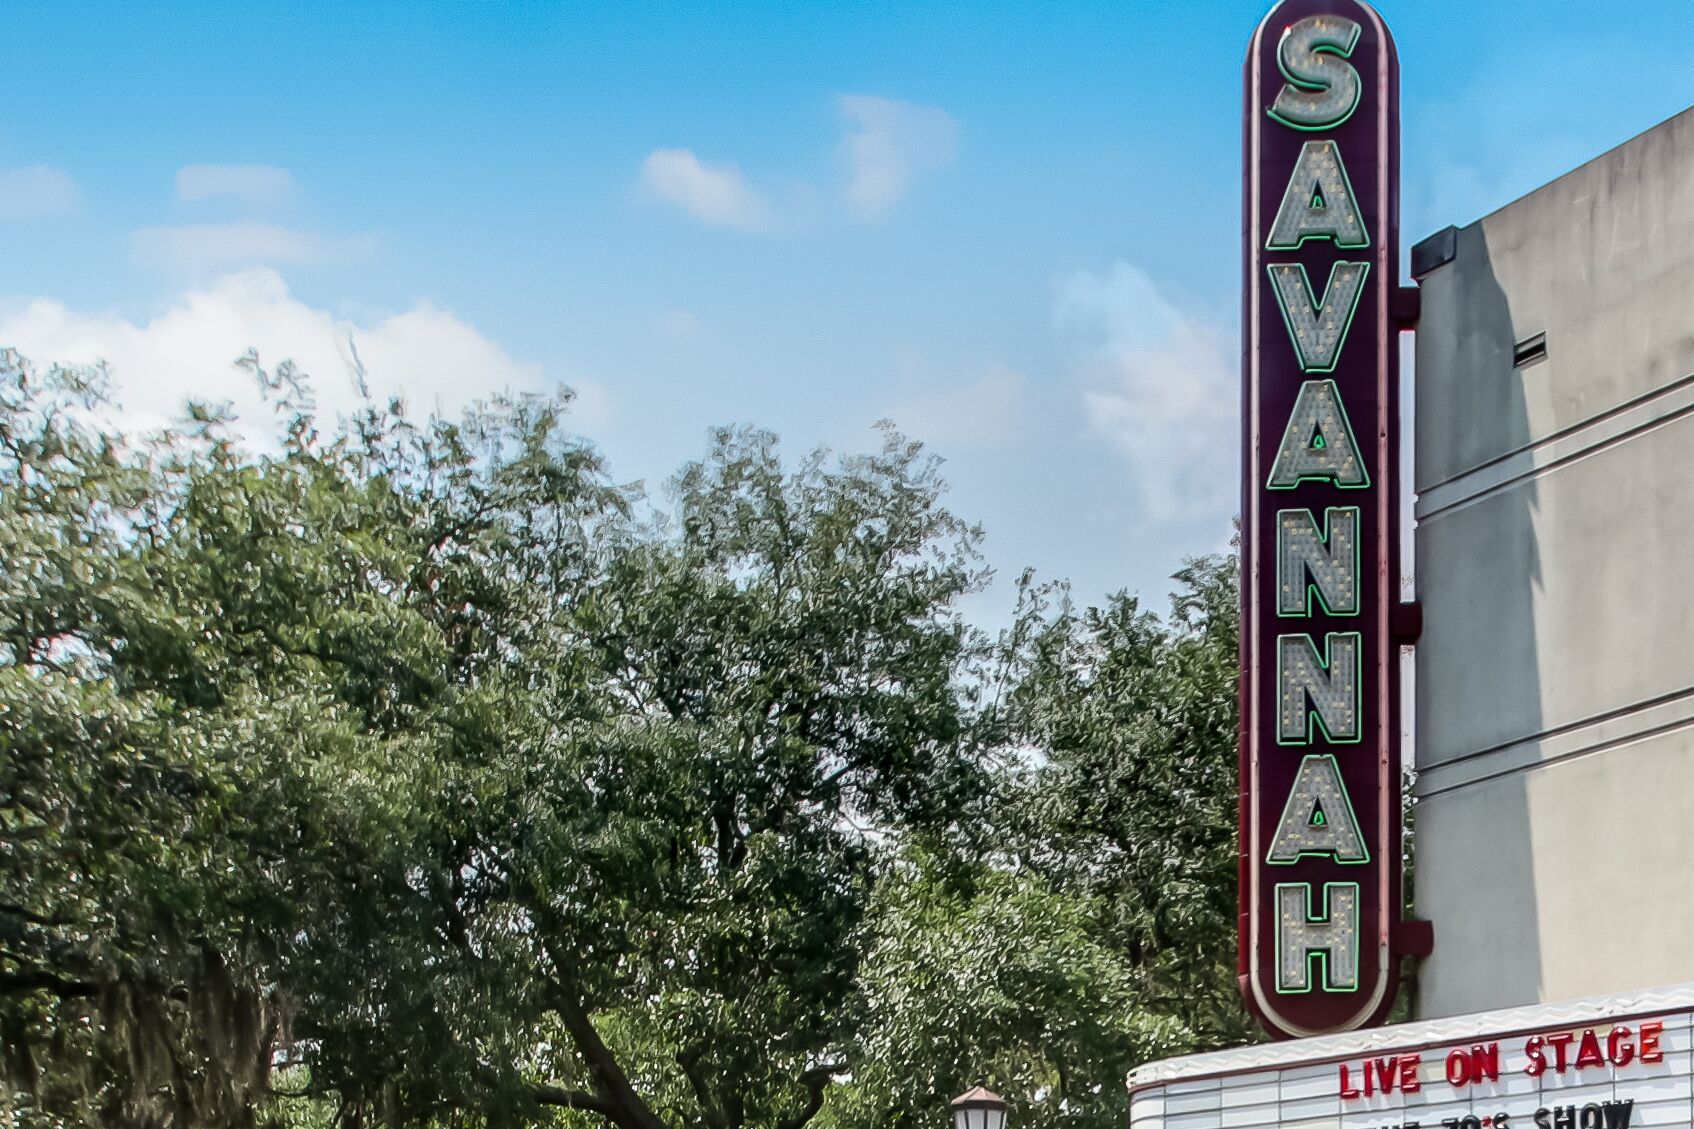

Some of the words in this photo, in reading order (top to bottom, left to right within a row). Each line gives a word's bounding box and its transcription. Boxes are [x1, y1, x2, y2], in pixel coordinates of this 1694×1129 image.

[1266, 14, 1371, 994] SAVANNAH
[1339, 1054, 1421, 1099] LIVE
[1445, 1042, 1499, 1087] ON
[1525, 1021, 1663, 1077] STAGE
